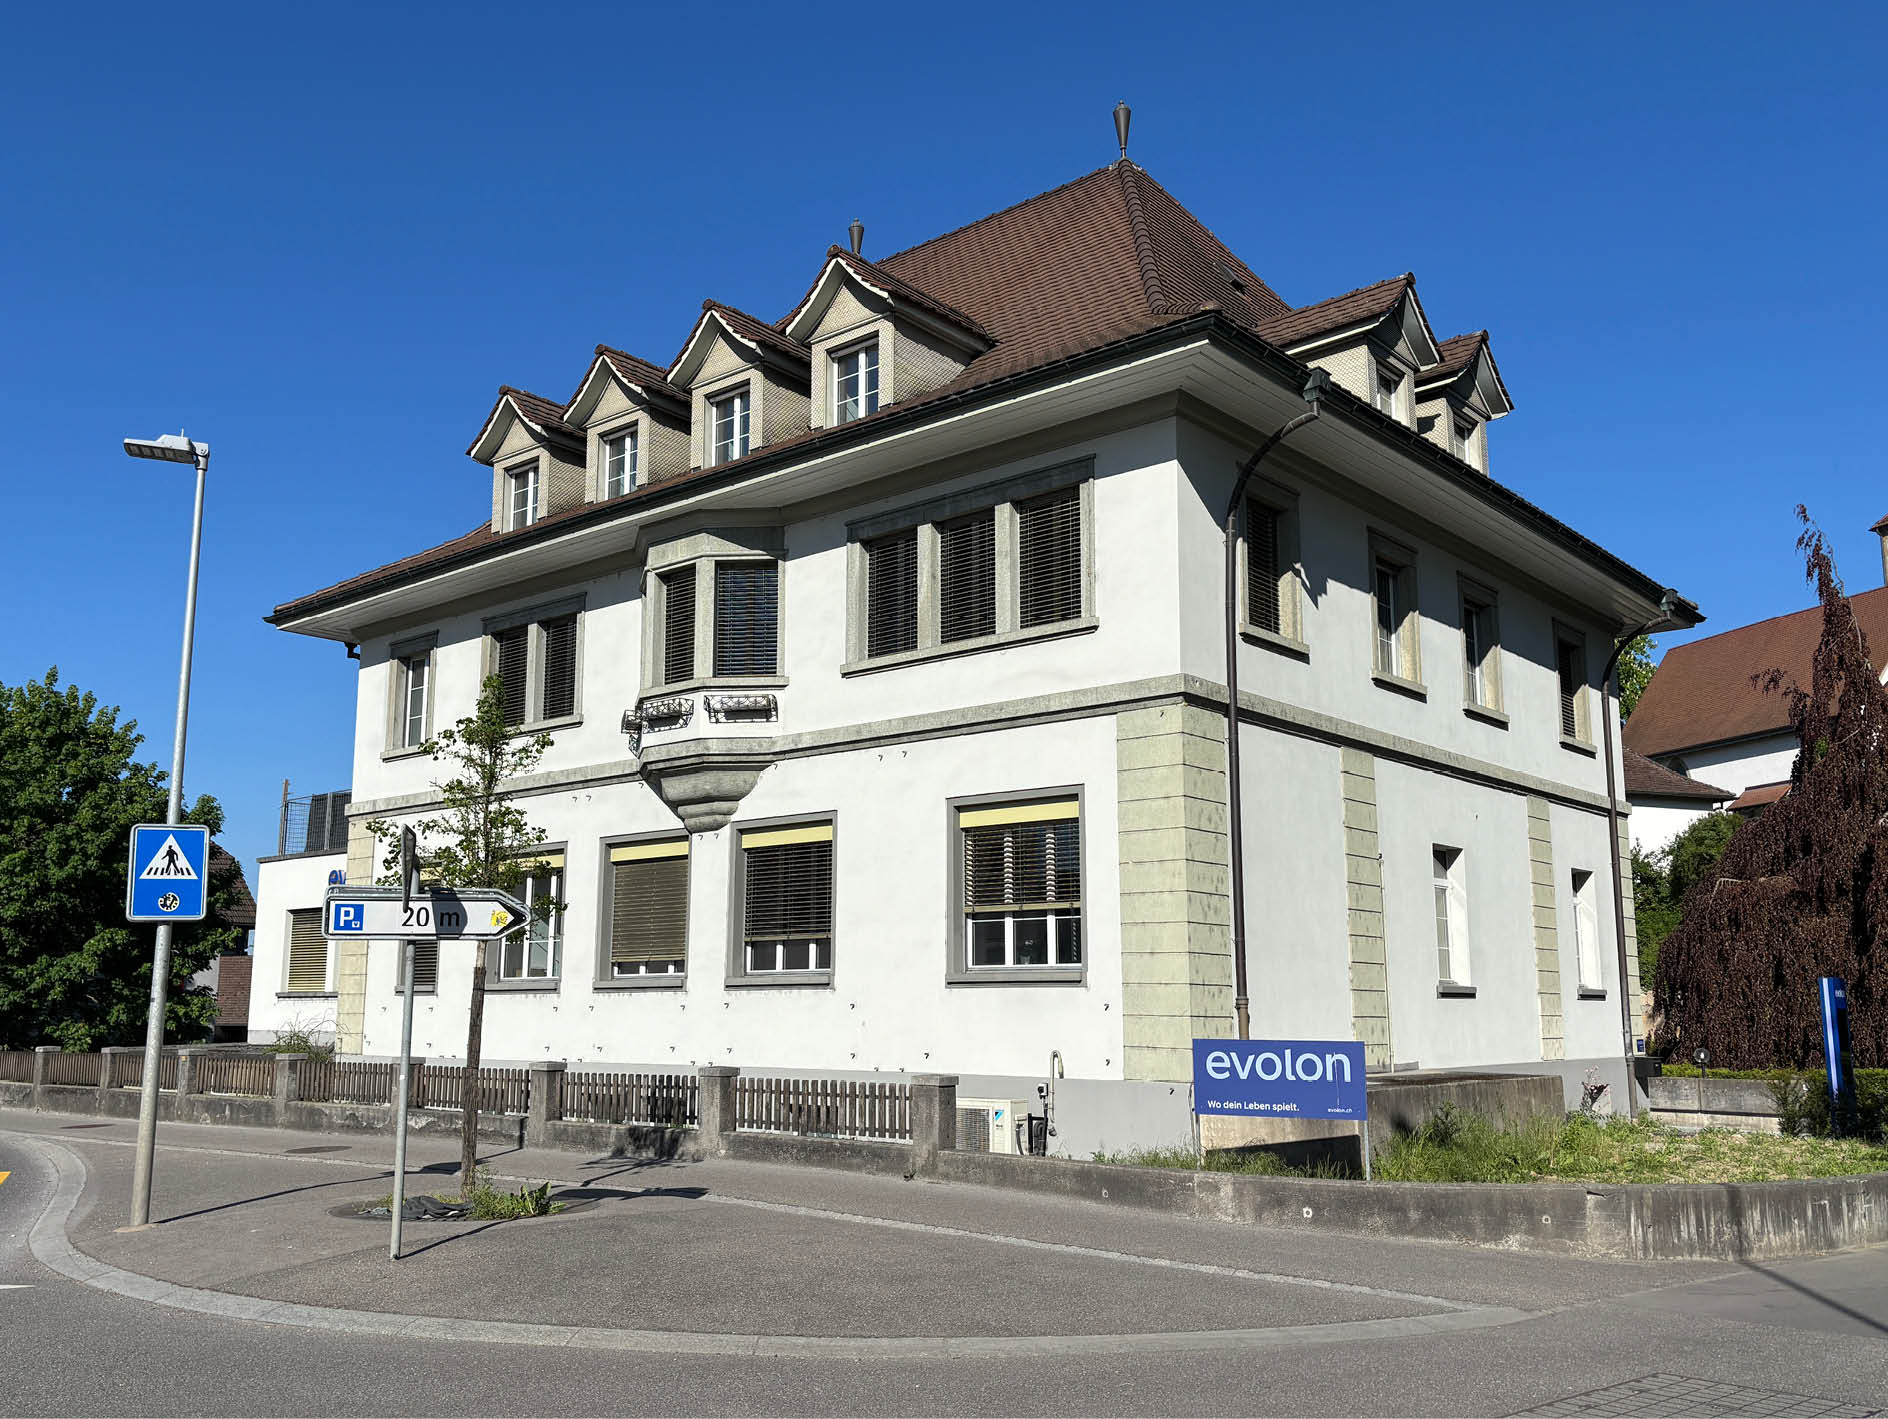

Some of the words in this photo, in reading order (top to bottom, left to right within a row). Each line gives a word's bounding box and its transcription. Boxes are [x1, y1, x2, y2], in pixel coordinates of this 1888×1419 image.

[339, 907, 354, 926] P
[402, 907, 430, 927] 20
[440, 911, 460, 927] m
[1205, 1048, 1352, 1082] evolon
[1207, 1100, 1221, 1109] Wo
[1223, 1100, 1242, 1110] dein
[1244, 1101, 1271, 1111] Leben
[1272, 1102, 1300, 1112] spielt.
